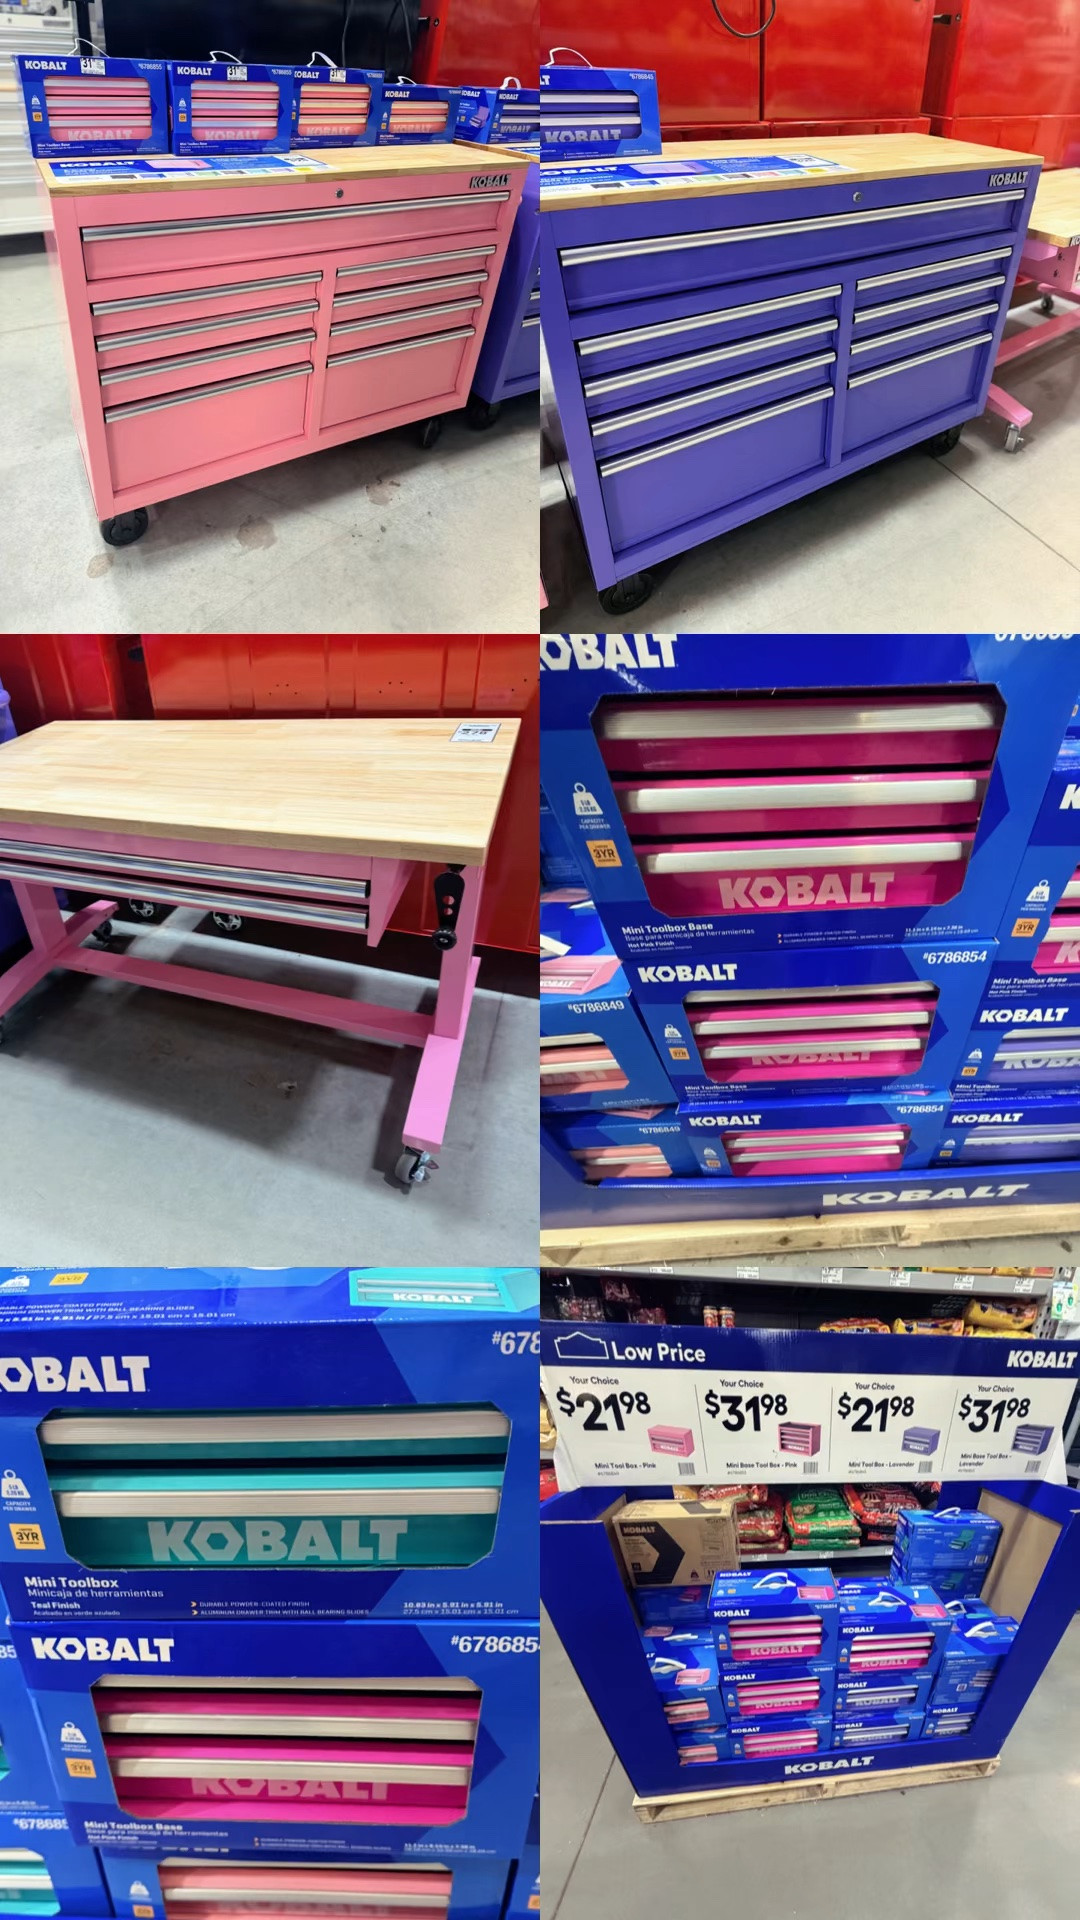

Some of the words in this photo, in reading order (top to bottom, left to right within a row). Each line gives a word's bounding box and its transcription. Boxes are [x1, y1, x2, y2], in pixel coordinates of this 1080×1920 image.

[24, 60, 67, 70] KOBALT
[177, 66, 212, 76] KOBALT
[545, 130, 621, 142] KOBALT
[470, 174, 512, 189] KOBALT
[989, 171, 1028, 187] KOBALT
[718, 872, 894, 910] KOBALT
[622, 925, 644, 934] Mini
[646, 924, 686, 933] Toolbox
[688, 922, 714, 930] Base
[663, 932, 694, 940] minicaja
[706, 928, 755, 936] herramientas
[923, 951, 987, 964] #6786854
[638, 963, 738, 983] KOBALT
[568, 1000, 625, 1014] #6786849
[980, 1008, 1070, 1023] KOBALT
[689, 1114, 762, 1127] KOBALT
[952, 1113, 1024, 1124] KOBALT
[822, 1184, 1030, 1206] KOBALT
[392, 1292, 474, 1304] KOBALT
[612, 1341, 652, 1361] Low
[656, 1342, 706, 1362] Price
[1007, 1350, 1078, 1368] KOBALT
[0, 1356, 150, 1392] OBALT
[569, 1376, 588, 1384] Your
[590, 1376, 620, 1385] Choice
[720, 1379, 738, 1388] Your
[738, 1380, 764, 1388] Choice
[855, 1382, 870, 1390] Your
[872, 1382, 895, 1390] Choice
[978, 1385, 992, 1393] Your
[992, 1385, 1014, 1393] Choice
[16, 1532, 39, 1540] 3YR
[148, 1520, 408, 1562] KOBALT
[24, 1576, 56, 1587] Mini
[58, 1577, 119, 1588] Toolbox
[28, 1588, 72, 1599] Minicaja
[75, 1589, 88, 1597] de
[91, 1589, 164, 1598] herramientas
[714, 1610, 750, 1618] KOBALT
[31, 1637, 174, 1662] KOBALT
[451, 1635, 540, 1653] #678685
[751, 1646, 804, 1656] KOBALT
[724, 1674, 756, 1682] KOBALT
[784, 1756, 875, 1775] KOBALT
[84, 1820, 108, 1829] Mini
[109, 1822, 153, 1830] Toolbox
